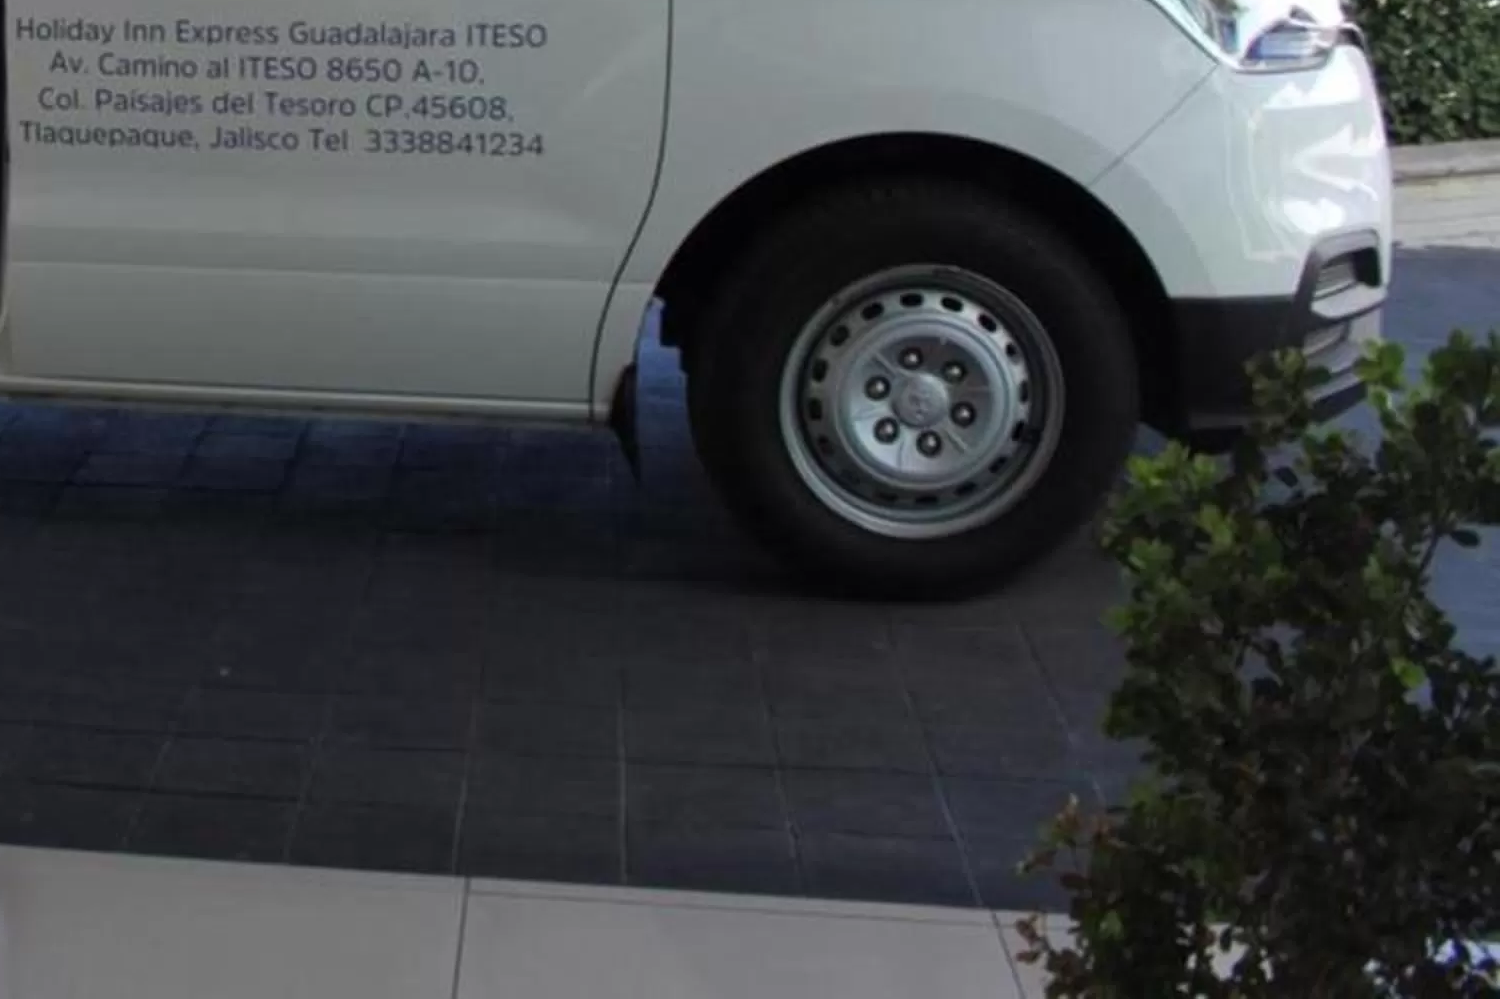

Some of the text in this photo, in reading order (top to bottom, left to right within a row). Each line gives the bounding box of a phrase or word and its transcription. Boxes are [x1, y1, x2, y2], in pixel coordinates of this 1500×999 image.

[16, 17, 548, 50] Holiday Inn Express Guadalajara ITESO
[50, 50, 90, 75] Av.
[98, 51, 199, 79] Camino
[206, 57, 230, 80] al
[239, 56, 318, 82] ITESO
[326, 56, 402, 84] 8650
[95, 88, 204, 117] Paisajes
[211, 91, 255, 115] del
[264, 91, 357, 119] Tesoro
[19, 121, 199, 150] Tlaquepaque,
[210, 126, 300, 151] Jalisco
[365, 129, 545, 156] 3338841234
